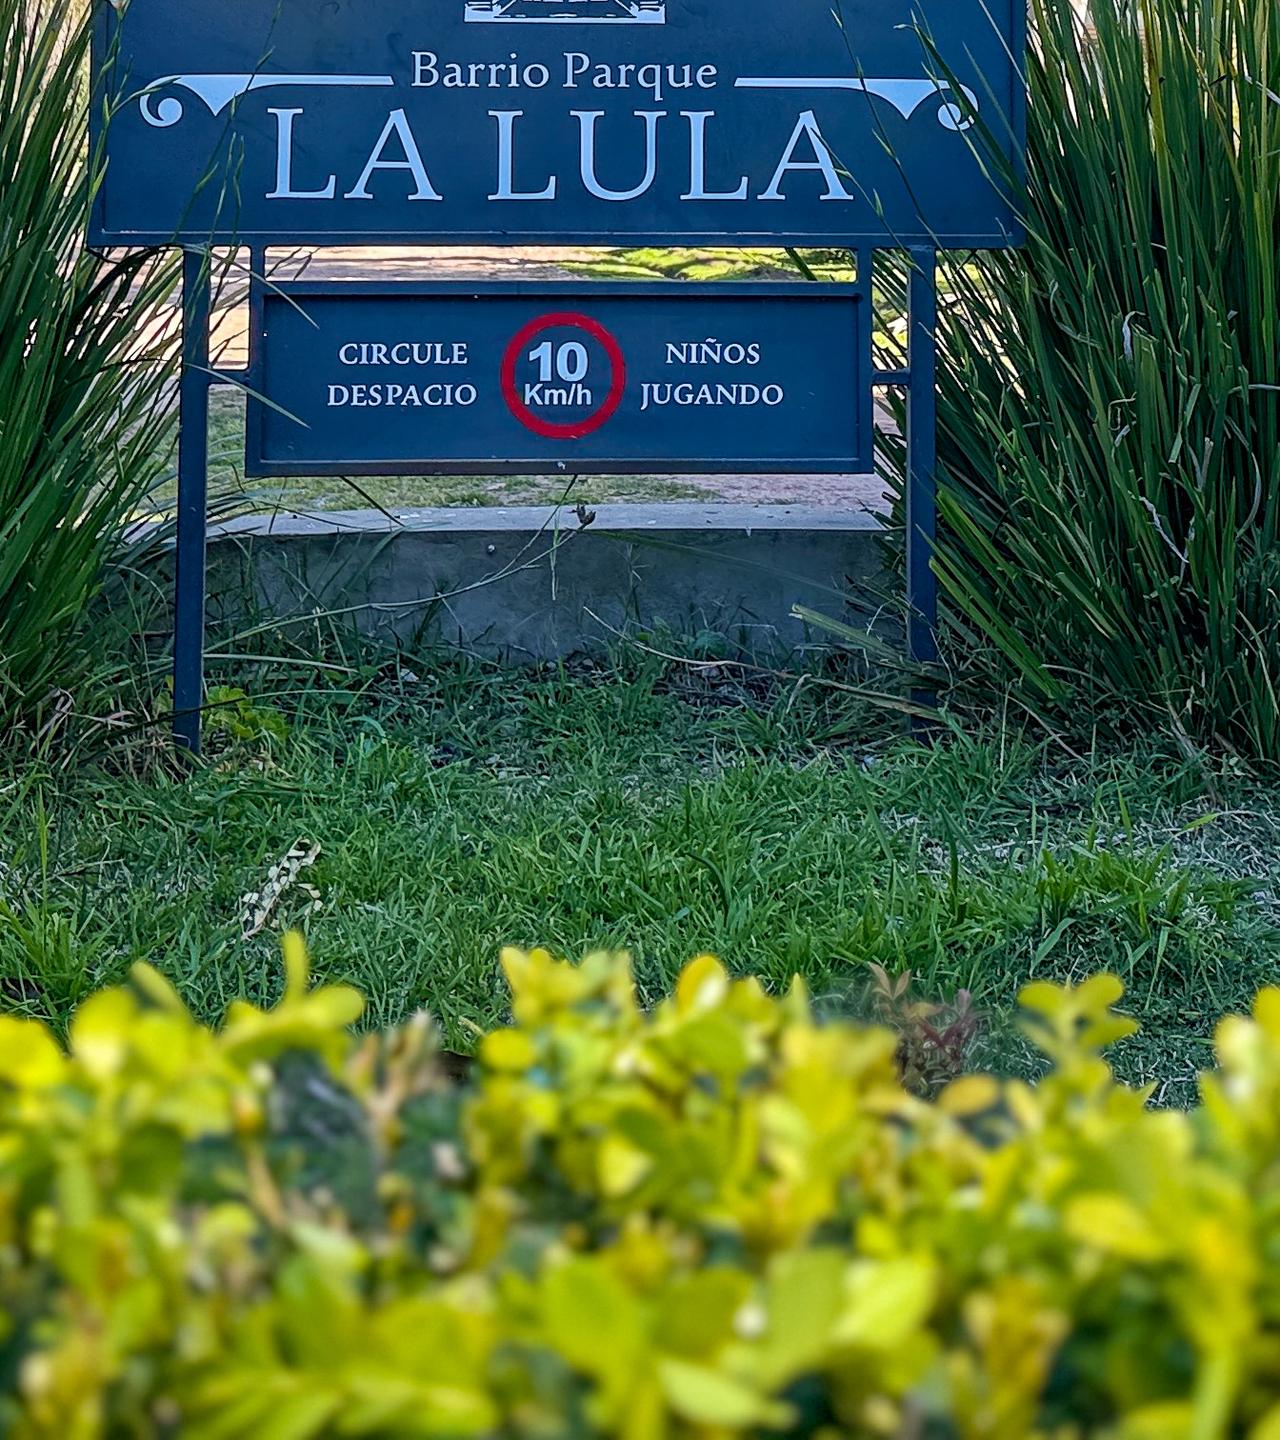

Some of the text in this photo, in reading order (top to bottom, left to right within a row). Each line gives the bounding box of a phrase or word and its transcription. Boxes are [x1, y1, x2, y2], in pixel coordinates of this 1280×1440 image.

[411, 51, 717, 102] Barrio Parque
[265, 107, 854, 201] LA LULA
[339, 343, 468, 365] CIRCULE
[529, 341, 588, 381] 10
[665, 337, 760, 365] NIÑOS
[327, 384, 477, 406] DESPACIO
[524, 383, 592, 406] Km/h
[640, 383, 784, 411] JUGANDO
